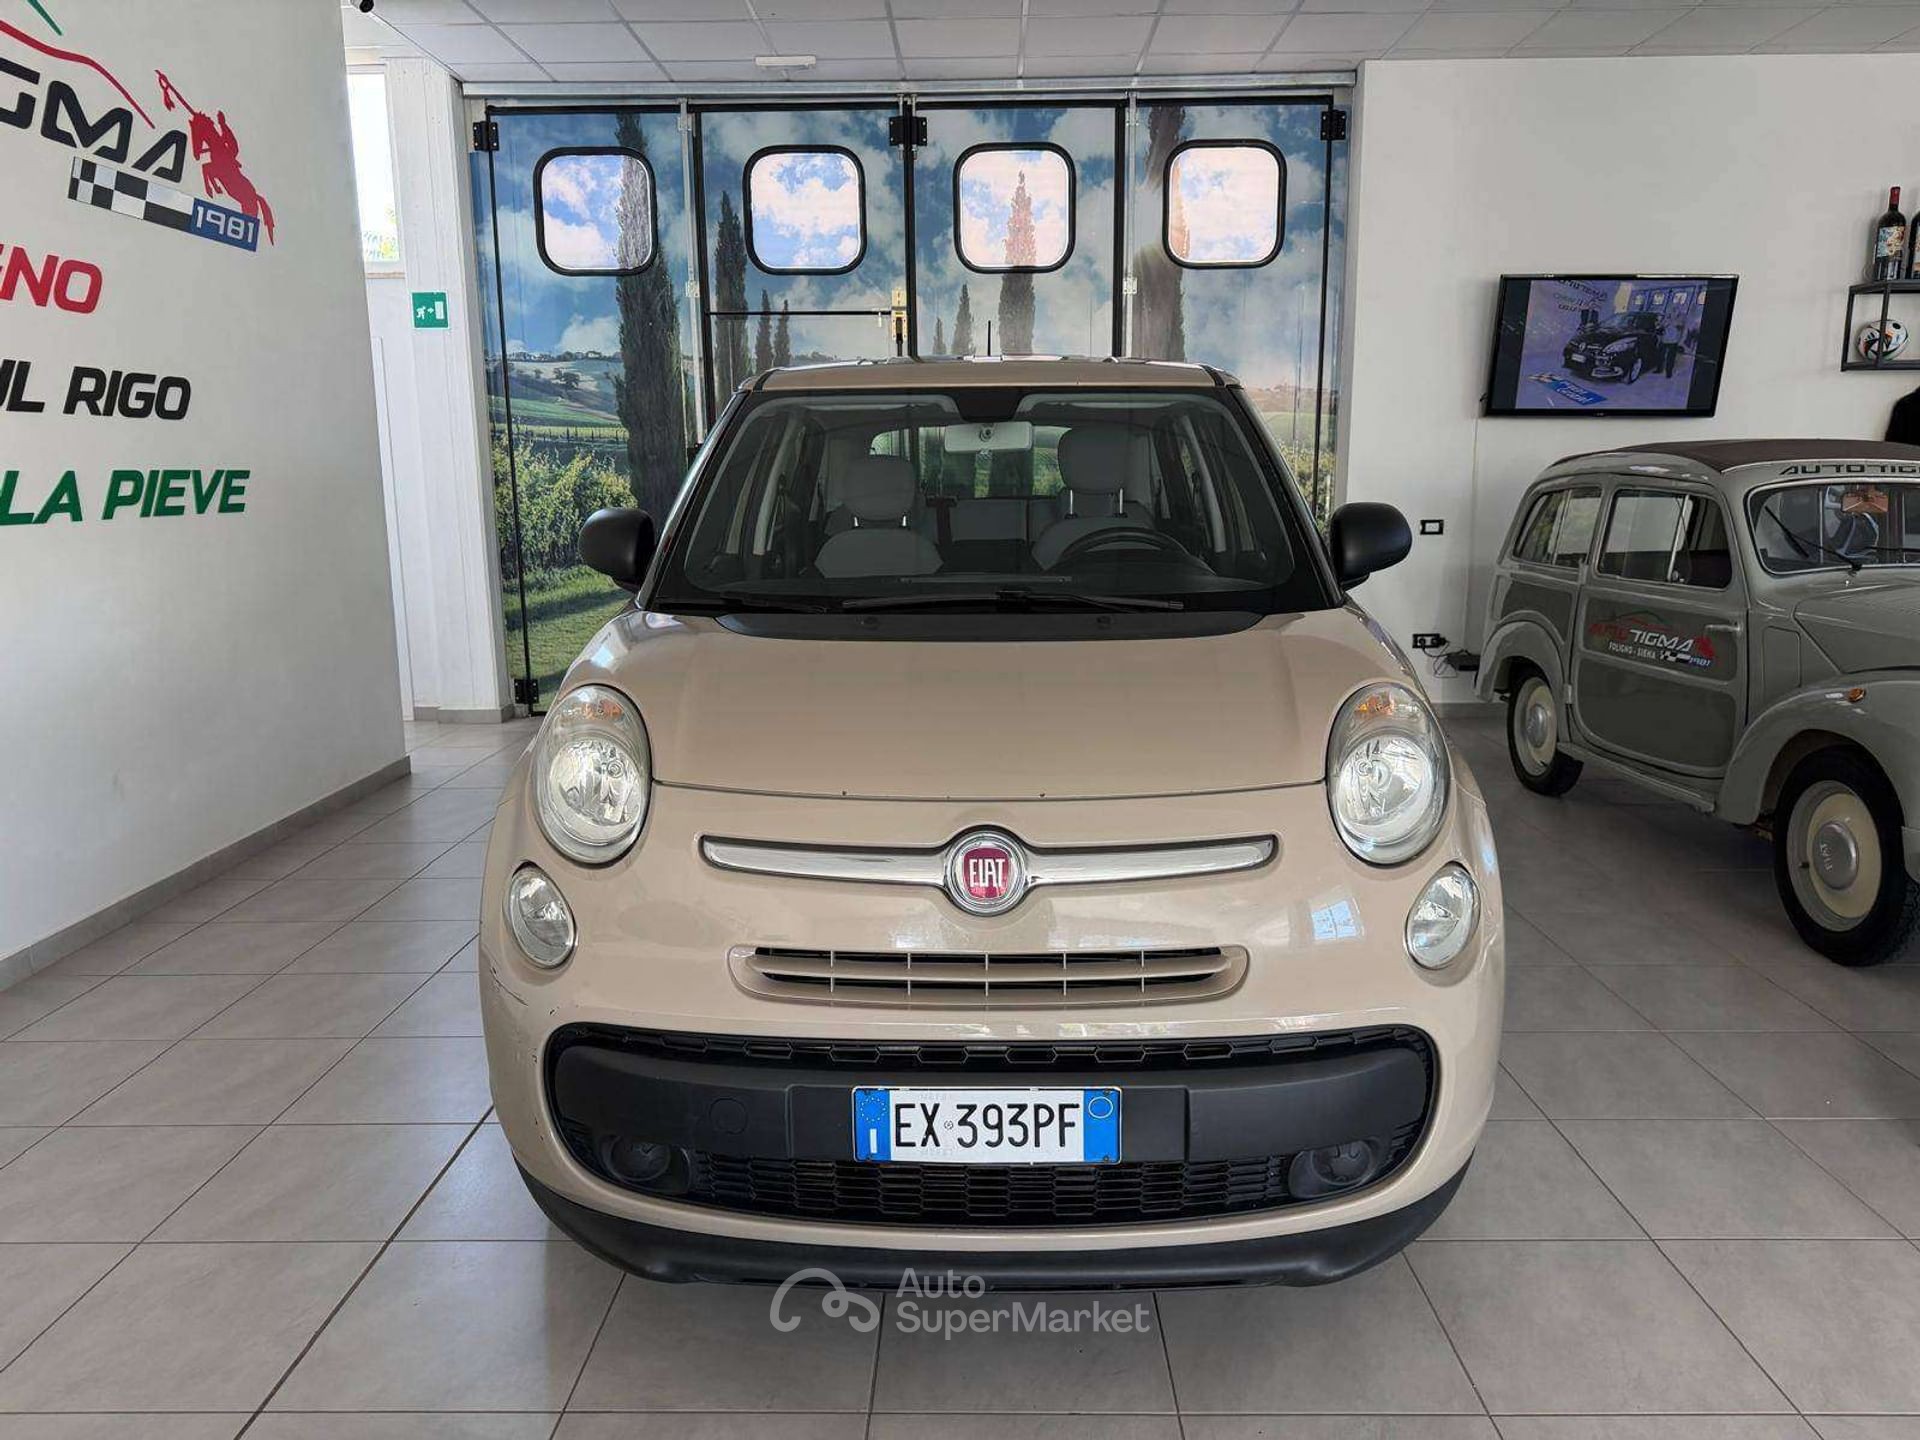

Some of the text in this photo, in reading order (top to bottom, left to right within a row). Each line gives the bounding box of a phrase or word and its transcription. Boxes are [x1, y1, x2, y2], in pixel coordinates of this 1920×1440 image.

[195, 204, 256, 244] 1981
[0, 243, 103, 314] NO
[63, 366, 191, 420] RIGO
[1780, 463, 1920, 475] AUTO TIG
[101, 469, 251, 520] PIEVE
[1629, 628, 1695, 652] TIGMA
[968, 858, 1006, 888] FIAT
[895, 1103, 940, 1148] EX
[956, 1103, 1080, 1148] 393PF
